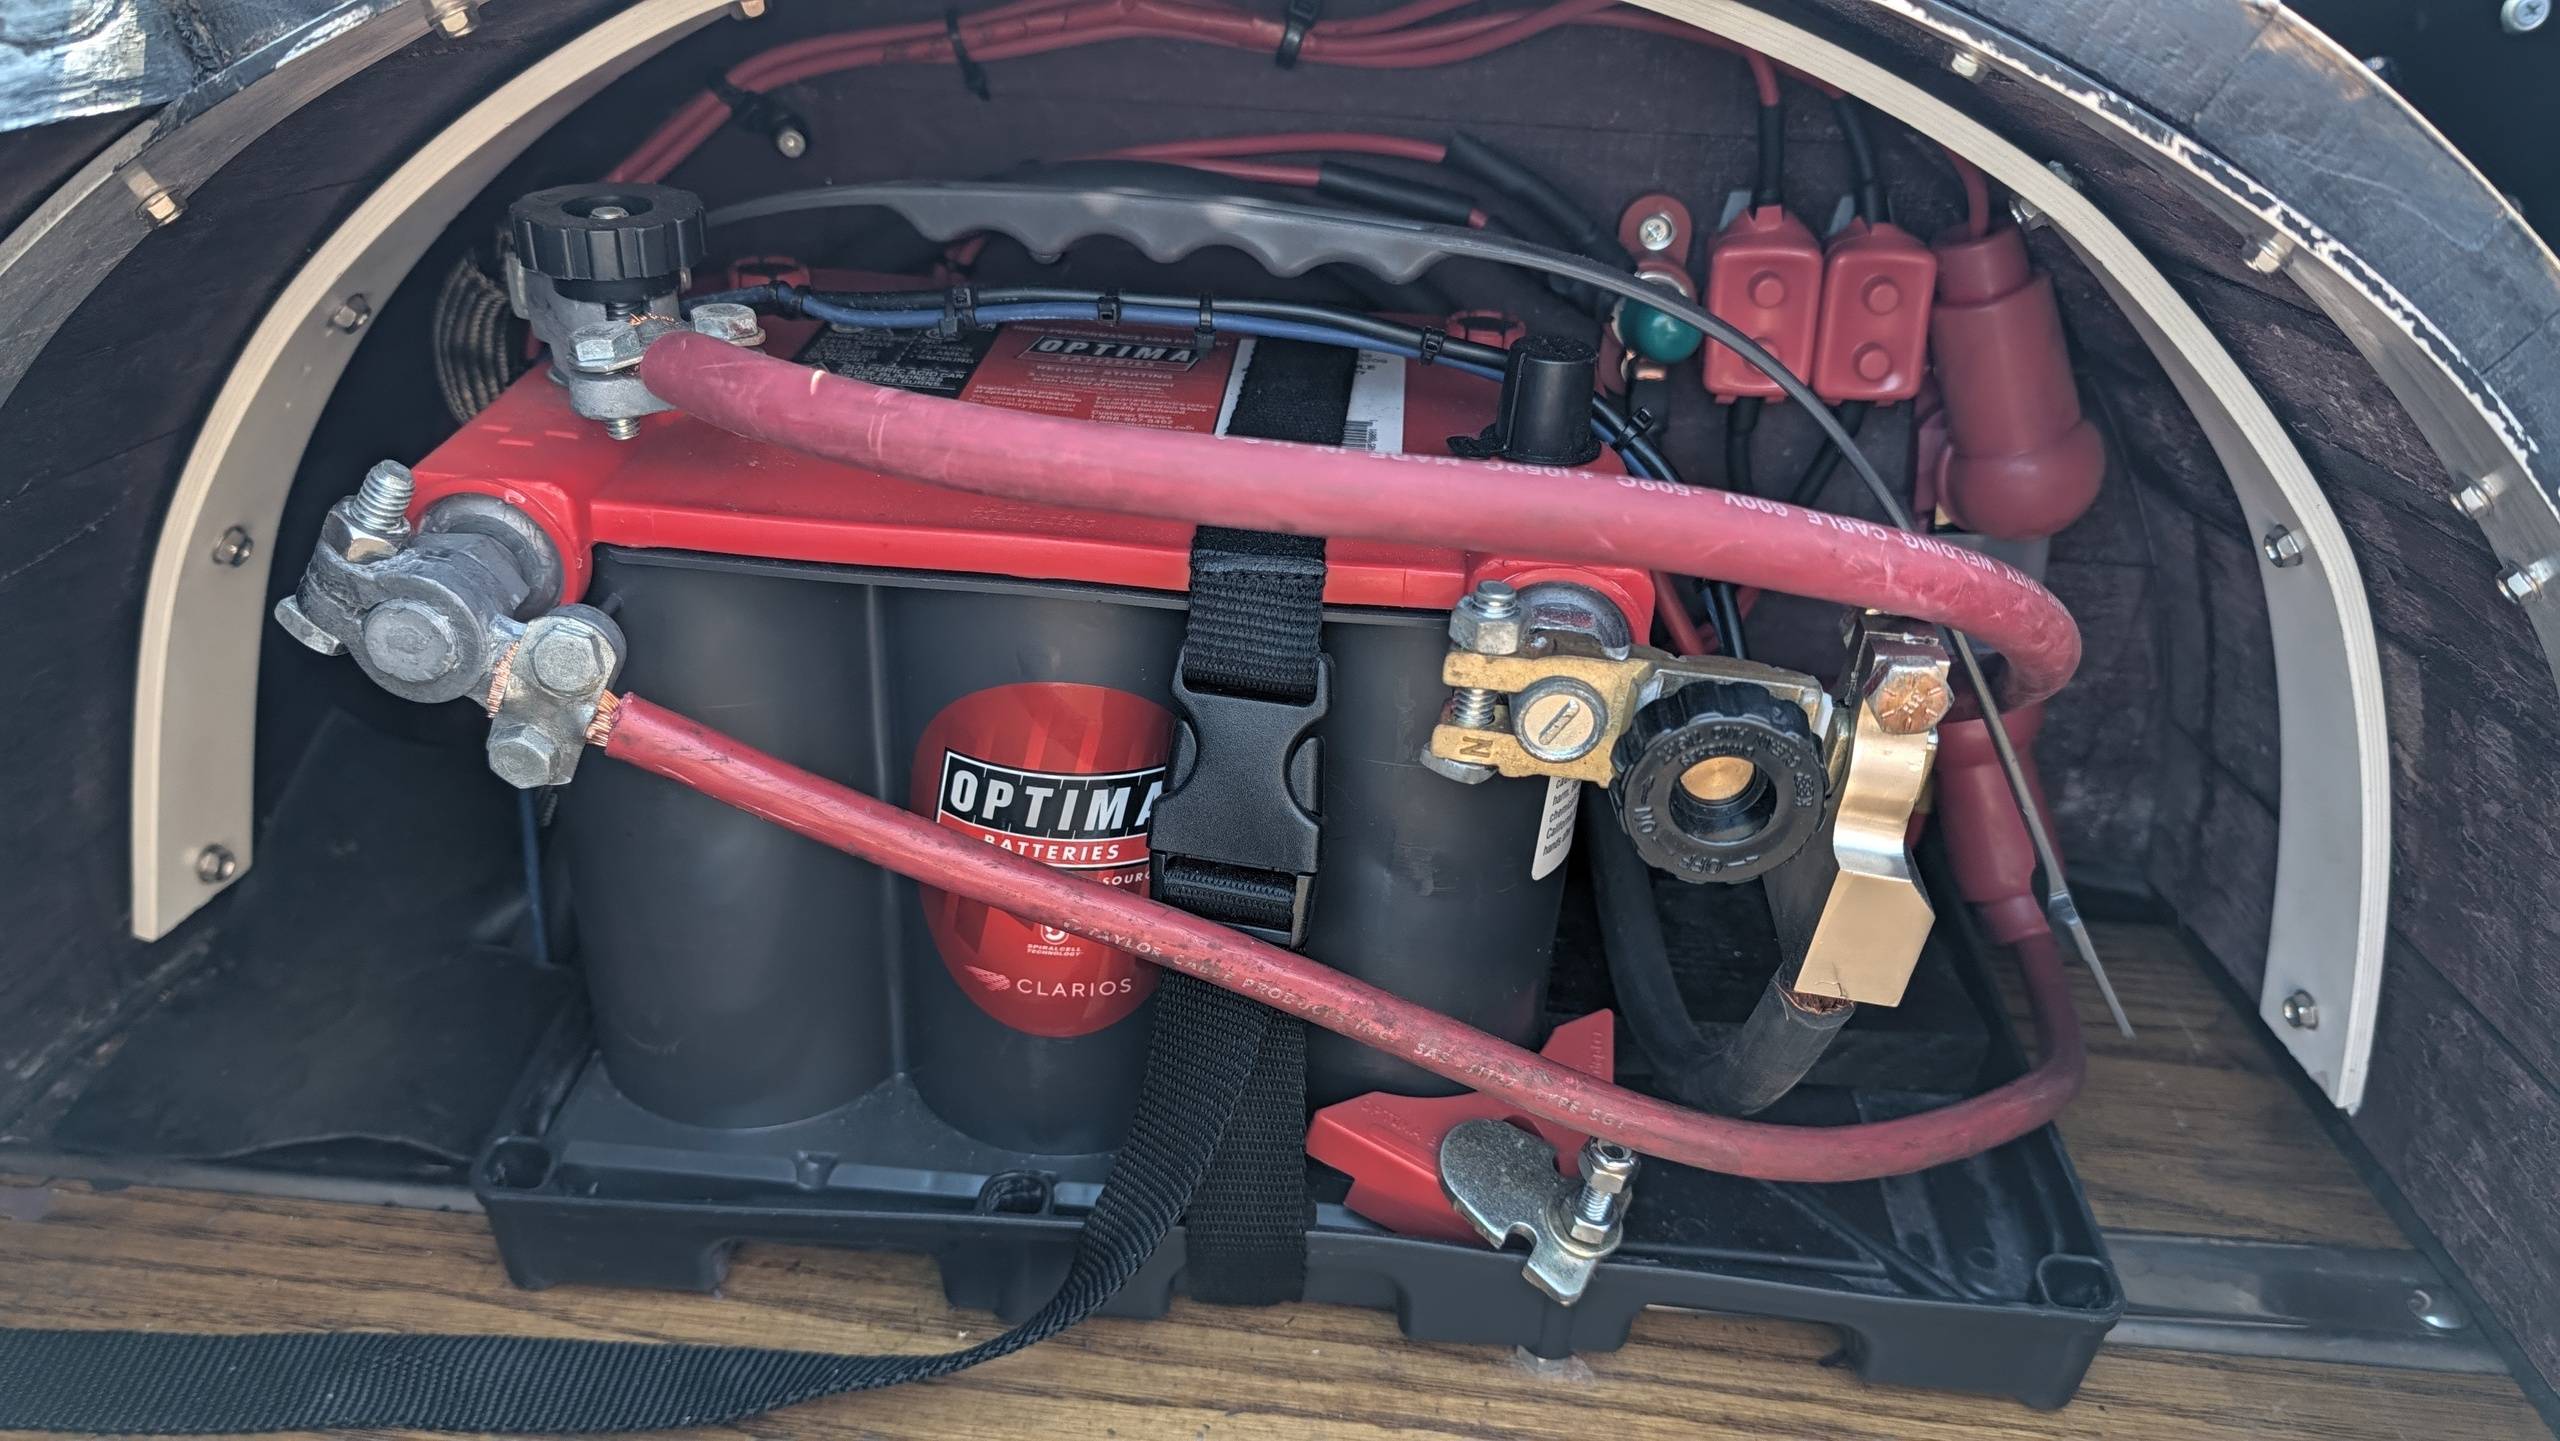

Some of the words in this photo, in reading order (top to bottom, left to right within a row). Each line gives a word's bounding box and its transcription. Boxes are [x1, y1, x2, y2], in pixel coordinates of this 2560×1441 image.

[1038, 340, 1194, 363] OPTIMA
[1805, 510, 1888, 541] CABLE
[1900, 530, 1996, 574] WELDING
[950, 769, 1164, 831] OPTIMA
[984, 834, 1120, 861] BATTERIES
[1102, 871, 1151, 886] SOURC
[1026, 943, 1081, 952] SPIRALCELL
[1026, 949, 1081, 957] TECHNOLOGY
[1017, 978, 1132, 998] CLARIOS
